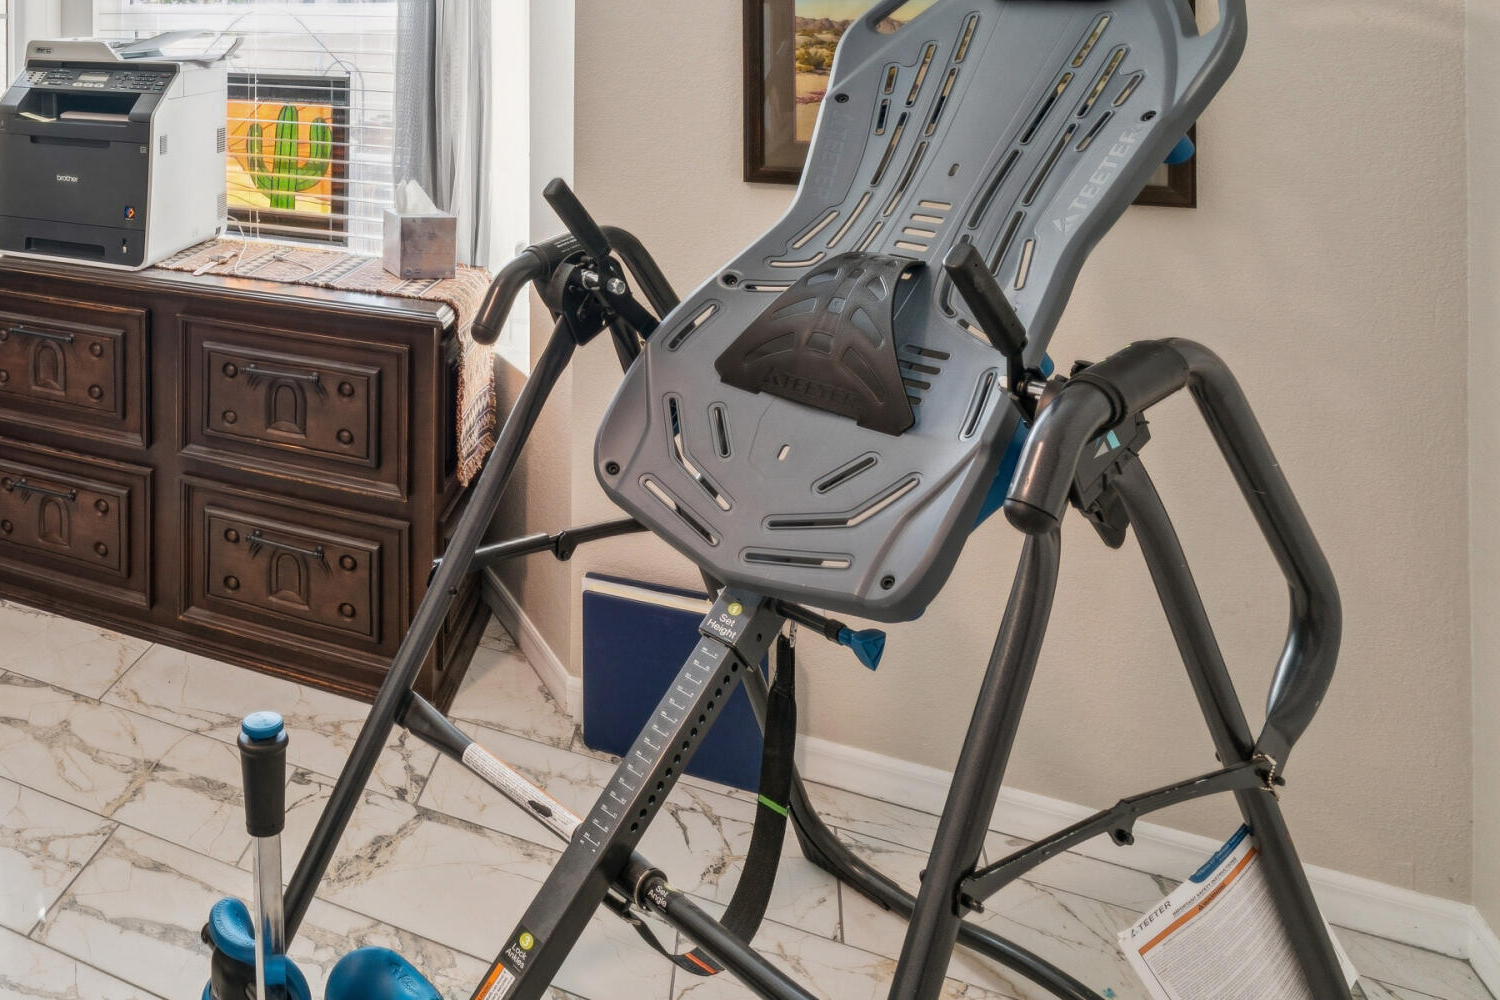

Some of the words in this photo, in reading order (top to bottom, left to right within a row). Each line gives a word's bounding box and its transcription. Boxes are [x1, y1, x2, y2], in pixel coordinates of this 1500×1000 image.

[56, 174, 78, 182] brother
[1068, 130, 1141, 211] TEETER
[706, 618, 737, 639] Height
[719, 613, 735, 627] Set
[647, 889, 667, 908] Angle
[655, 885, 669, 898] Set
[1138, 900, 1172, 932] TEETER
[505, 947, 525, 969] Ankles
[511, 942, 528, 961] Lock
